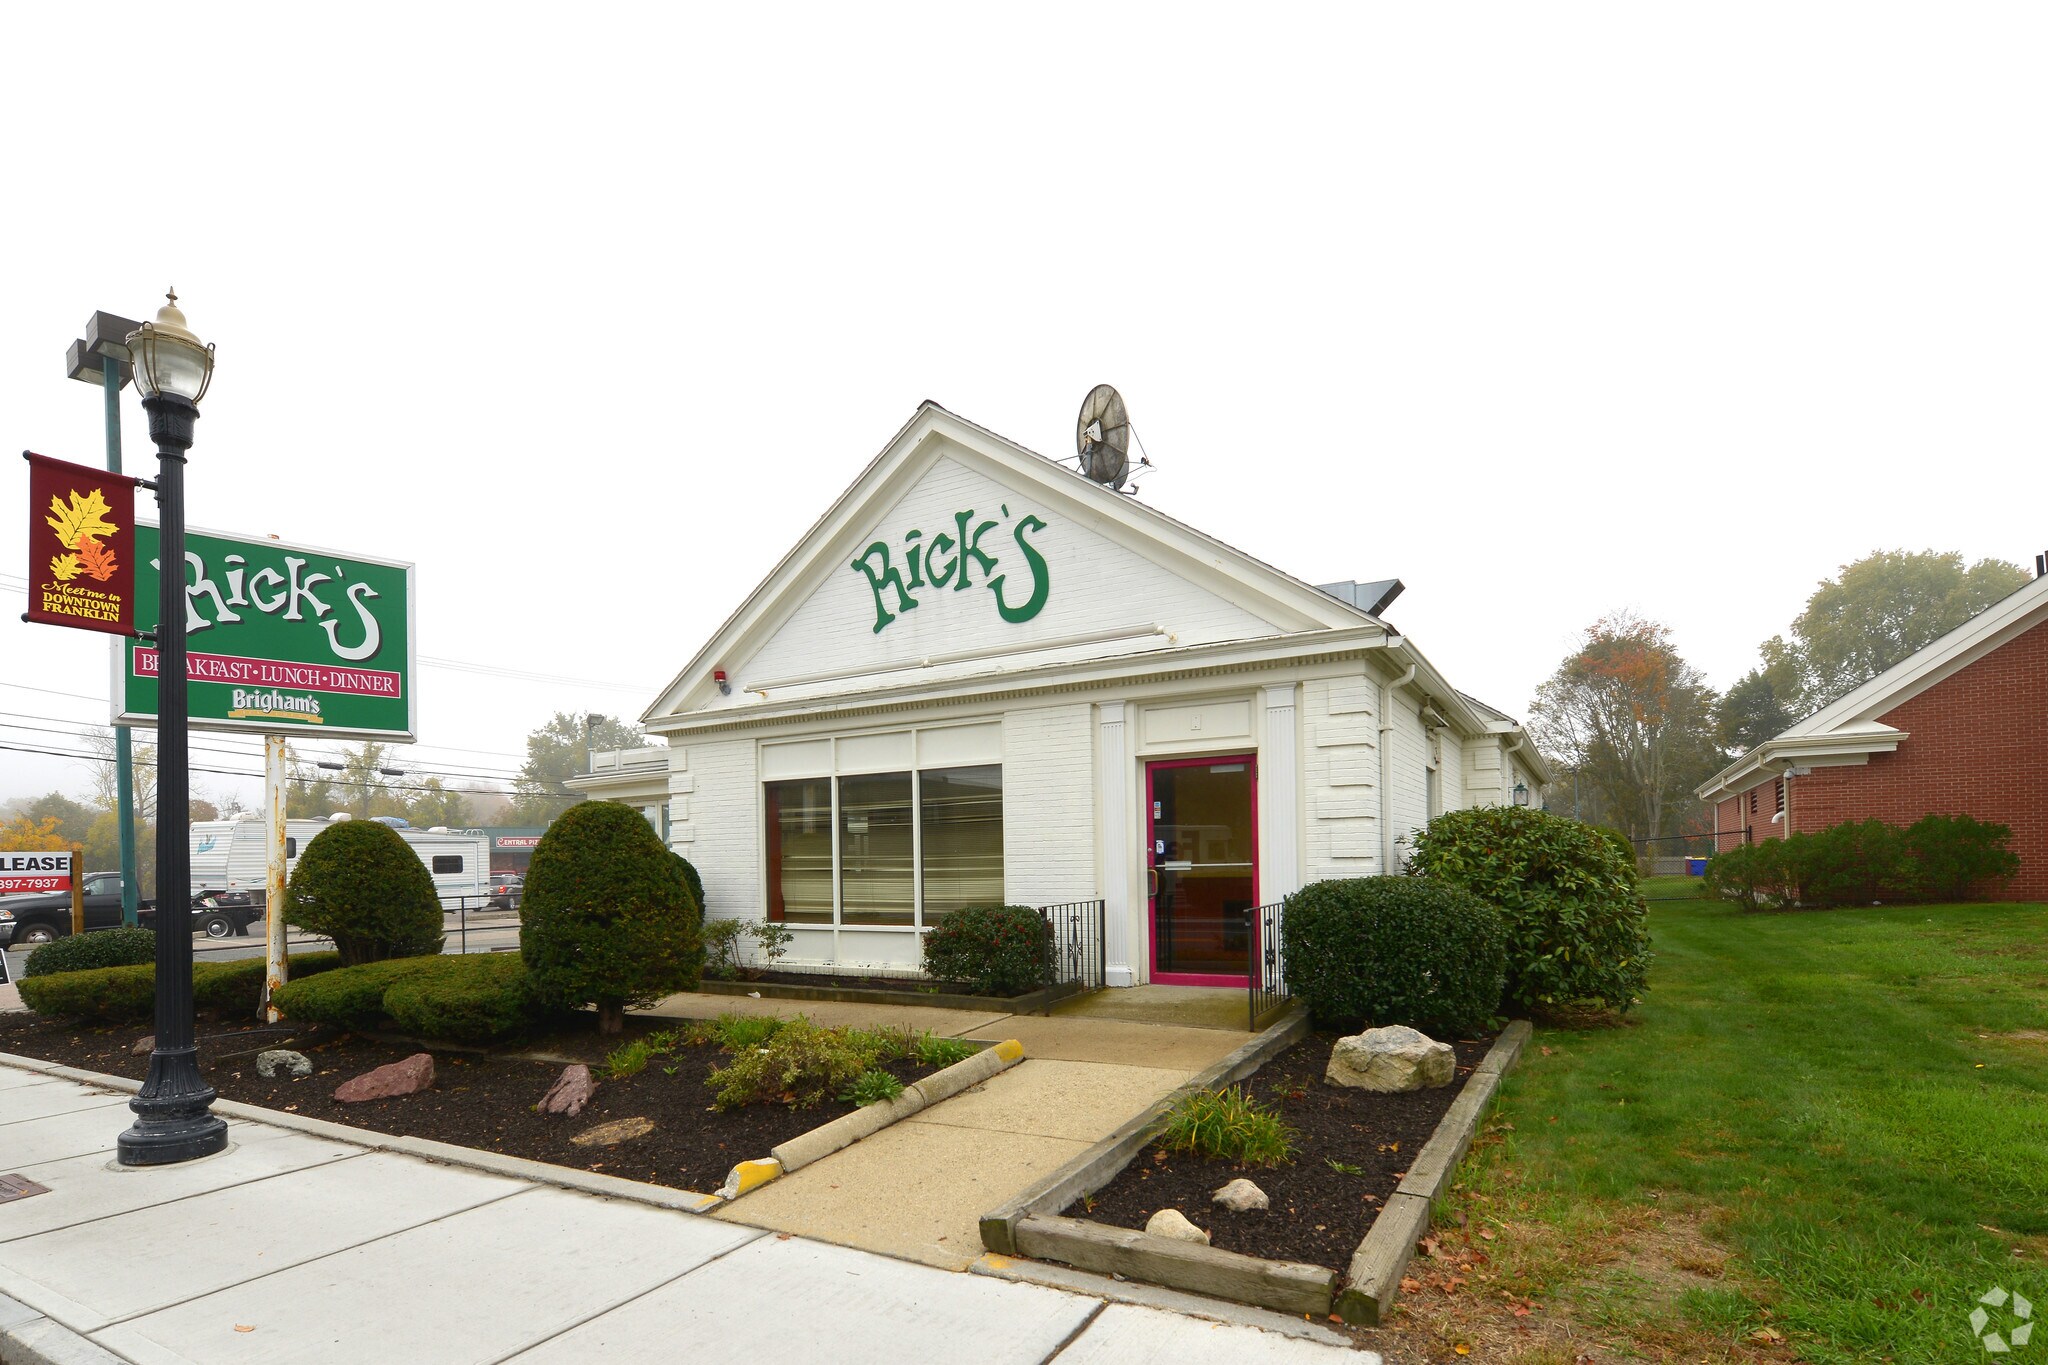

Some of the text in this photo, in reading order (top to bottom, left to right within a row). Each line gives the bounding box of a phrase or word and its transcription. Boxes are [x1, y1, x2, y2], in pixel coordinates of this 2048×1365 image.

[41, 580, 121, 602] Meet me in
[42, 591, 120, 613] DOWNTOWN
[42, 601, 120, 623] FRANKLIN
[260, 665, 321, 686] LUNCH
[329, 671, 395, 692] DINNER
[232, 688, 321, 714] Brigham's
[0, 857, 68, 871] LEASE
